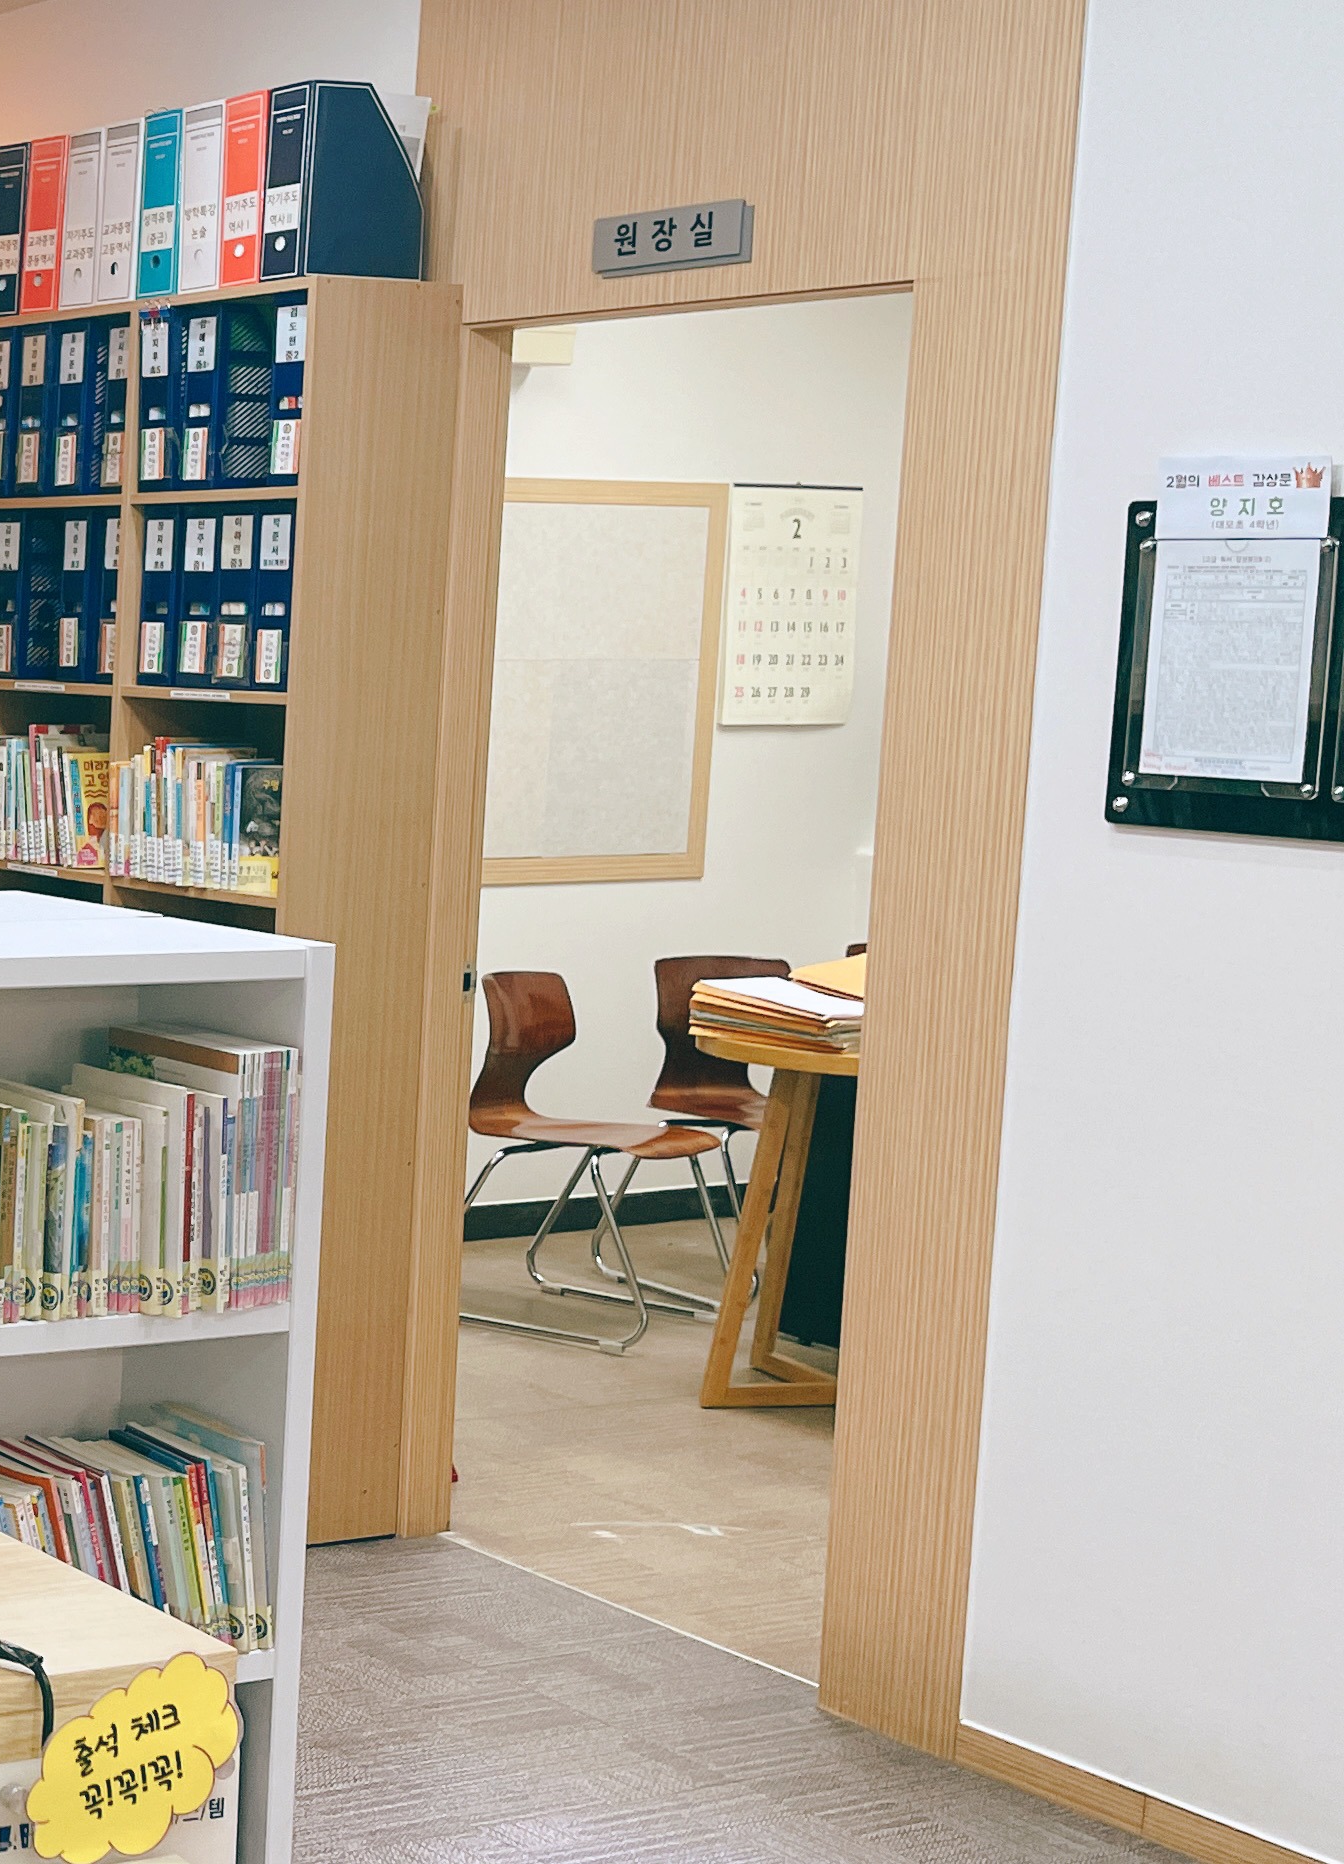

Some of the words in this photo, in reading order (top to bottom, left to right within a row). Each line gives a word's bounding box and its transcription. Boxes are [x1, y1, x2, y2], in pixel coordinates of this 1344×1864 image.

[226, 196, 256, 212] 자기주도
[267, 190, 298, 206] 자기주도
[192, 226, 207, 240] 논술
[614, 211, 714, 257] 원장실
[1166, 474, 1200, 488] 2월의
[1208, 474, 1244, 487] 베스트
[1252, 474, 1292, 488] 감상문
[793, 518, 801, 539] 2
[809, 558, 814, 568] 1
[825, 557, 830, 568] 2
[842, 557, 847, 569] 3
[770, 621, 779, 632] 13
[787, 621, 796, 632] 14
[803, 622, 812, 632] 15
[819, 622, 828, 633] 16
[836, 622, 845, 633] 17
[73, 1723, 119, 1778] 출석
[130, 1704, 181, 1741] 체크
[79, 1750, 184, 1820] 꼭!꼭!꼭!
